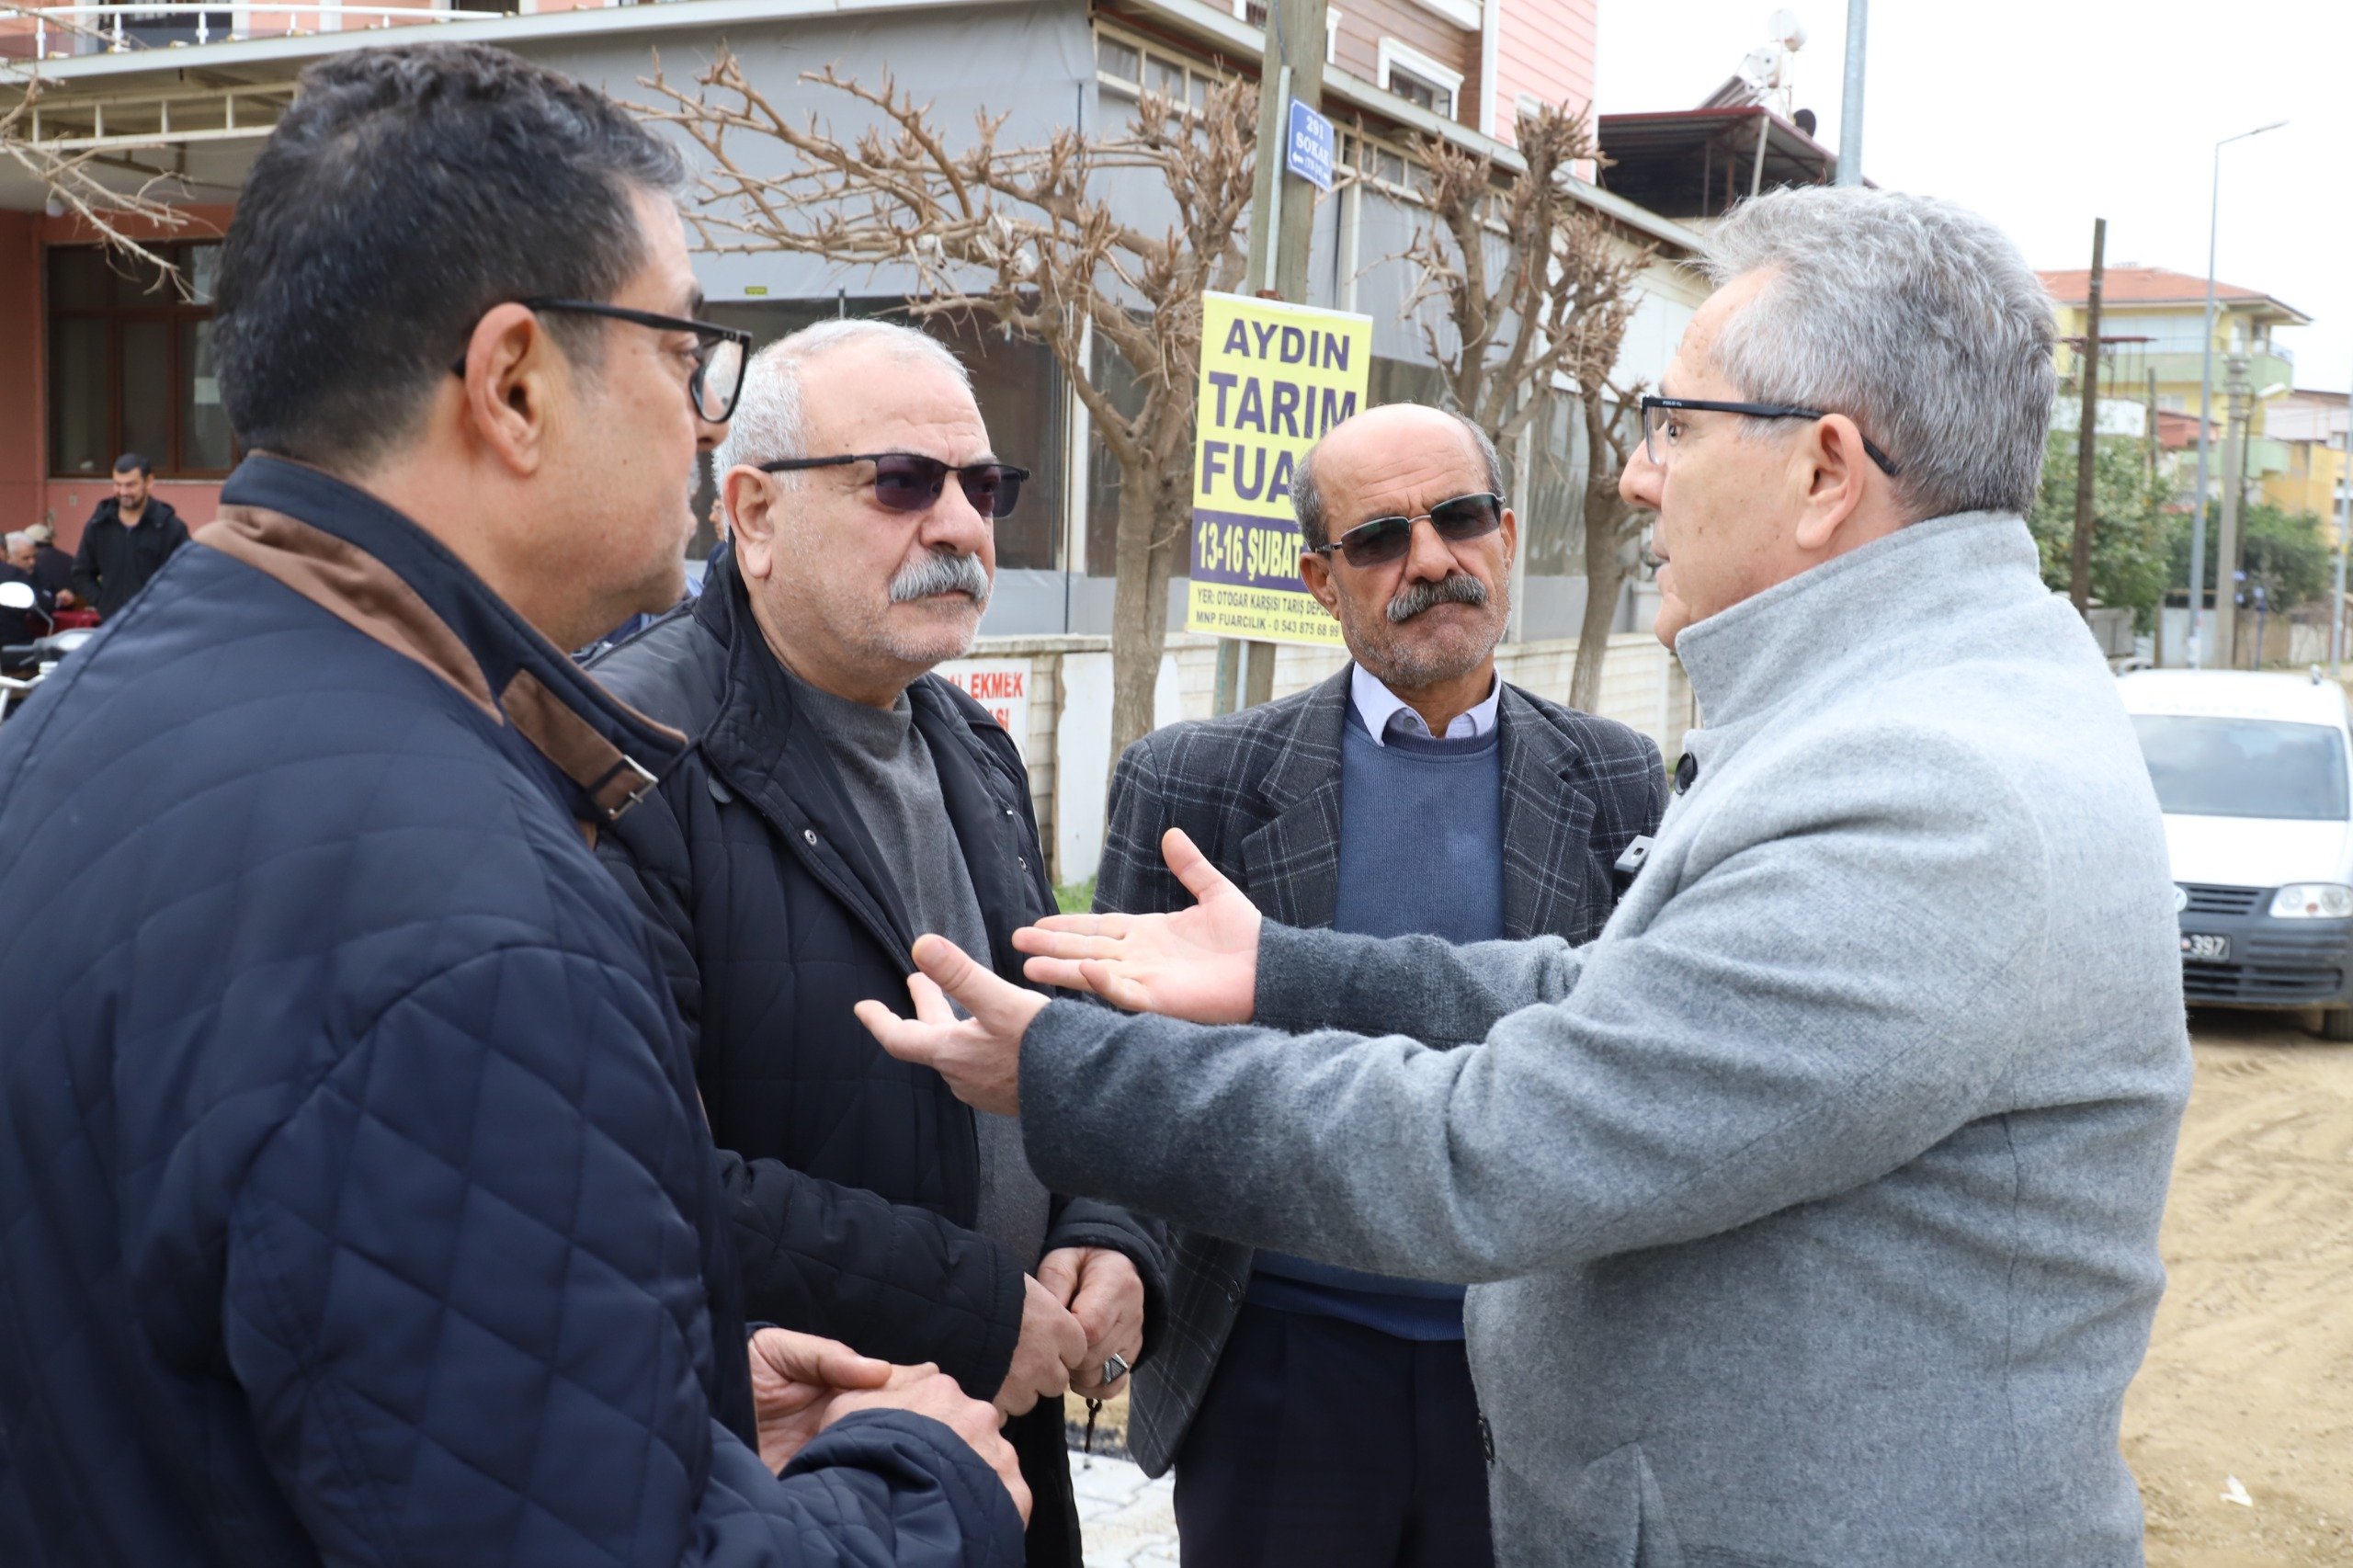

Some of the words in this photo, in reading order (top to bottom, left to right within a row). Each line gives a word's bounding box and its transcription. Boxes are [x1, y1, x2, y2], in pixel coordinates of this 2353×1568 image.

[1296, 131, 1329, 166] SOKAK
[1222, 318, 1350, 371] AYDIN
[1208, 370, 1357, 439] TARIM
[1201, 439, 1294, 503] FUA
[1198, 521, 1244, 573] 13-16
[1246, 528, 1304, 581] ŞUBAT
[1217, 590, 1248, 607] OTOGAR
[1196, 611, 1216, 625] MNP
[1219, 613, 1266, 630] FUARCILIK
[1281, 619, 1297, 633] 543
[972, 672, 1023, 699] EKMEK
